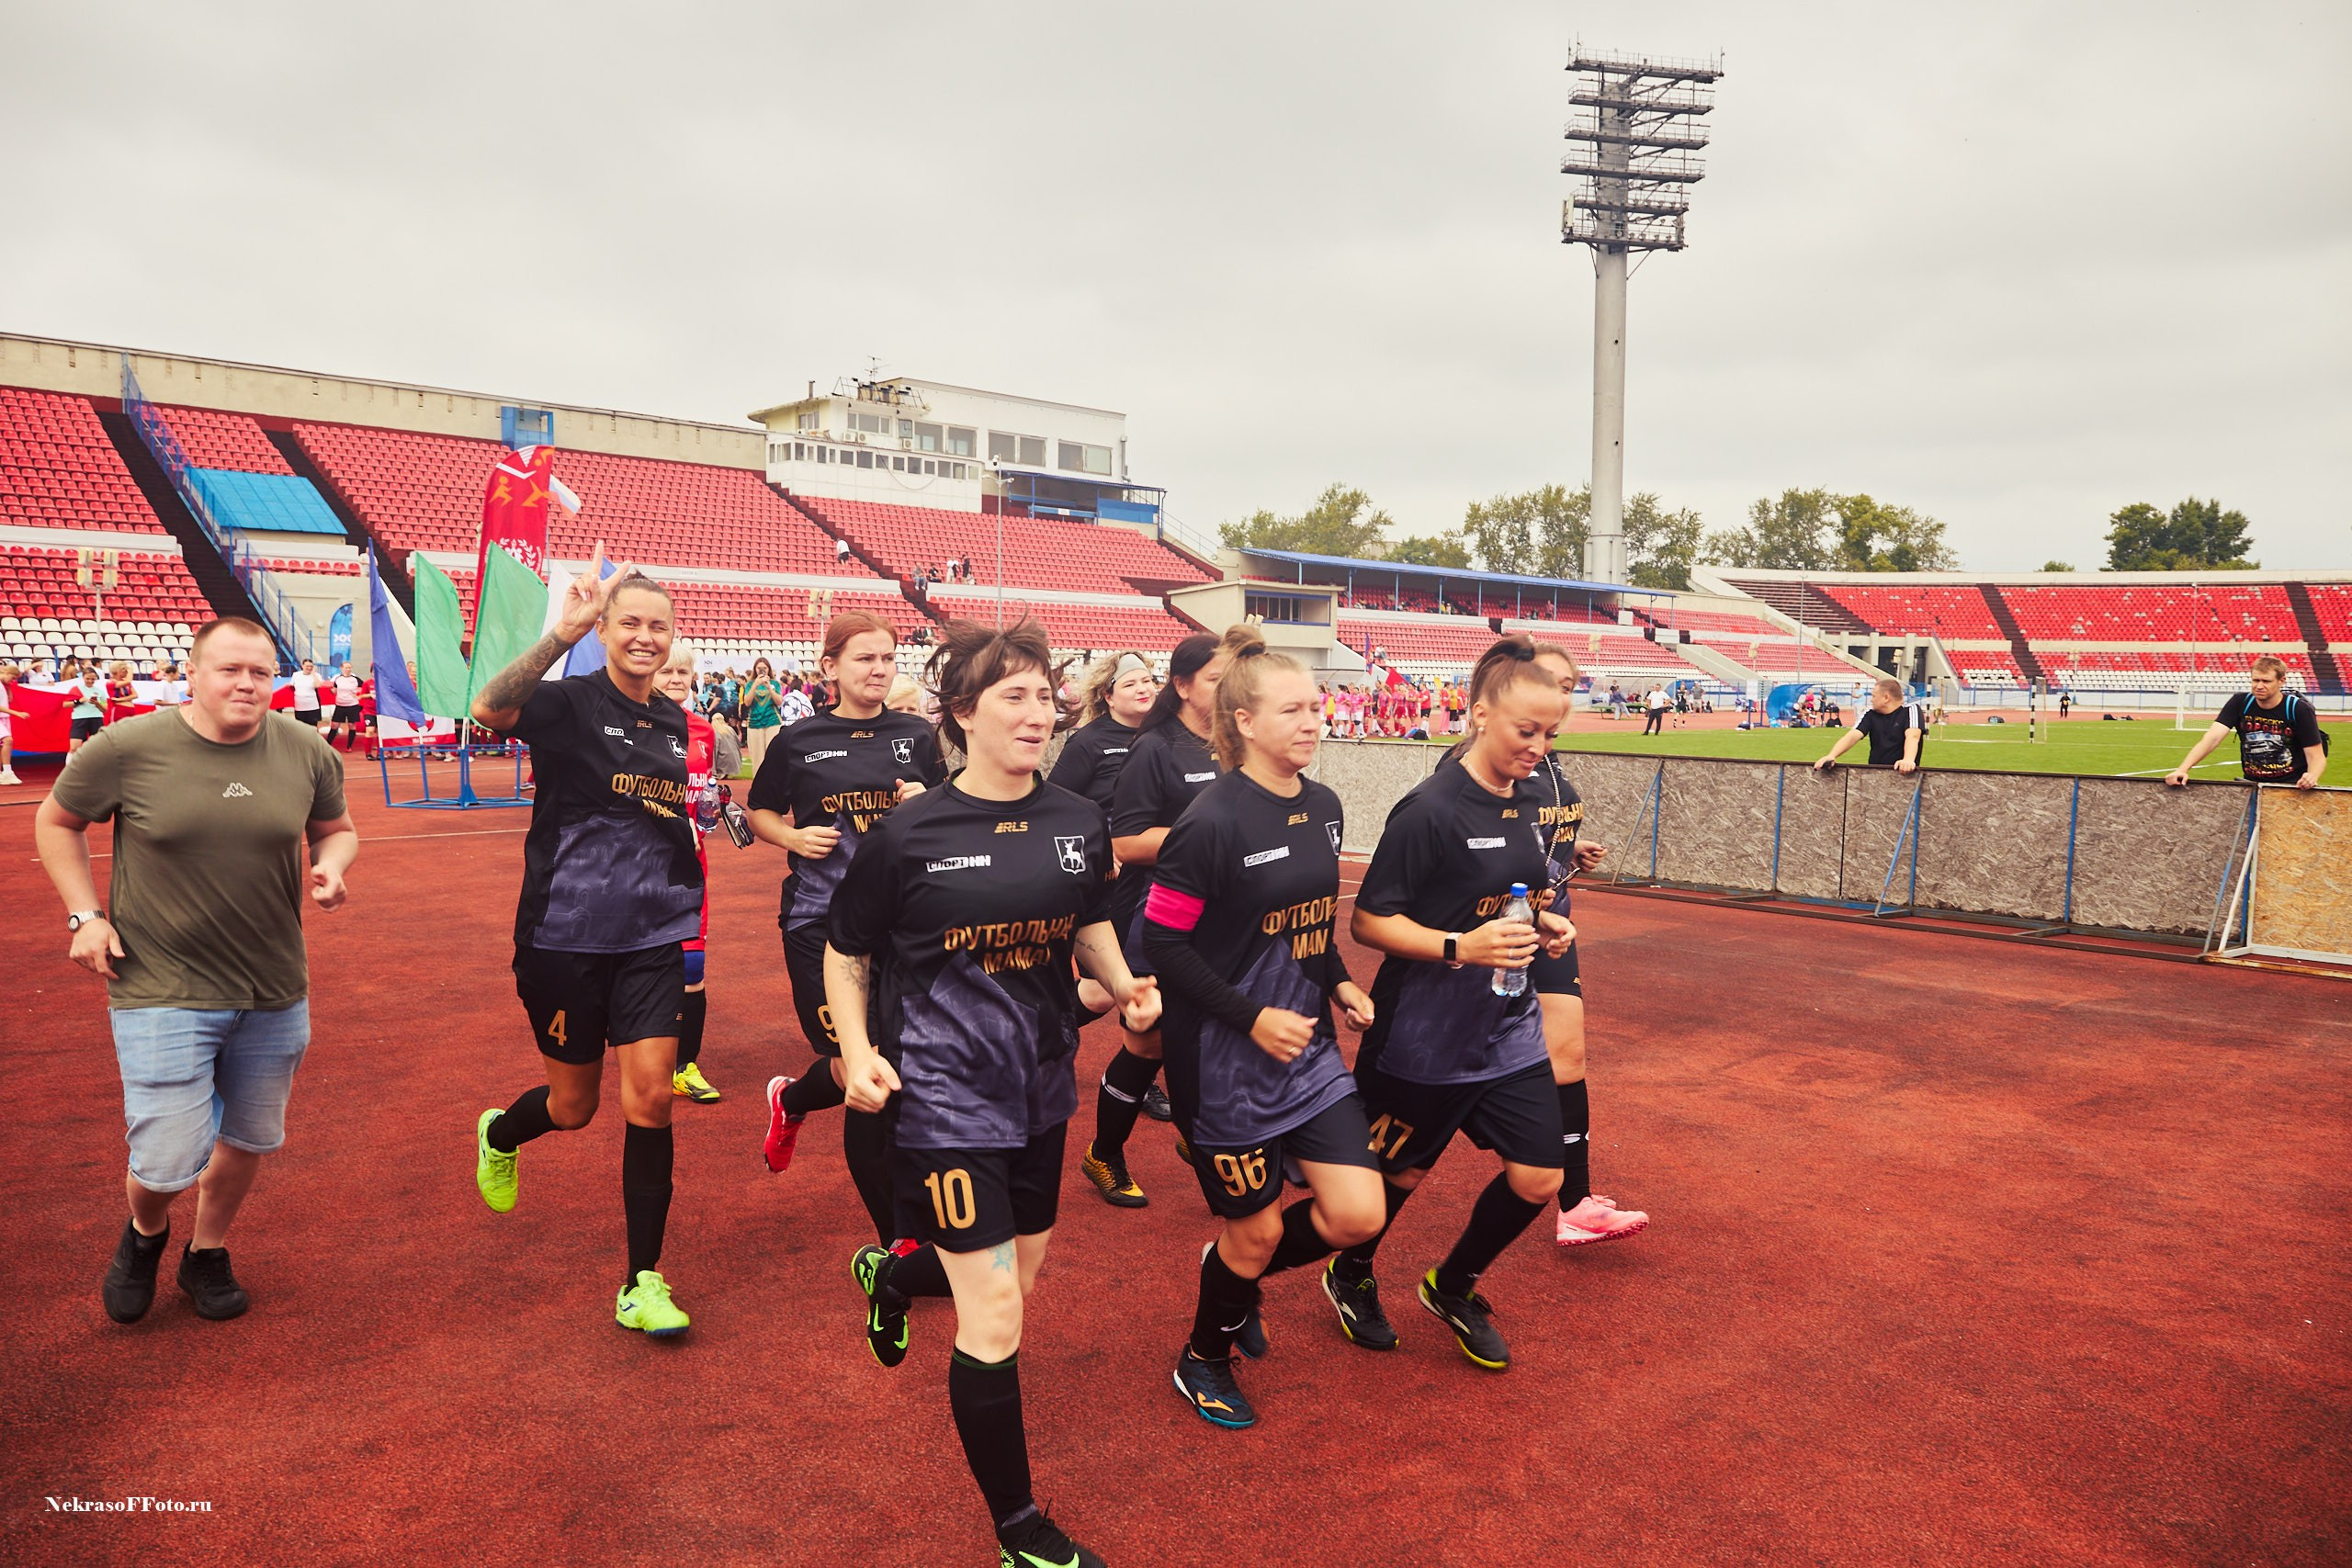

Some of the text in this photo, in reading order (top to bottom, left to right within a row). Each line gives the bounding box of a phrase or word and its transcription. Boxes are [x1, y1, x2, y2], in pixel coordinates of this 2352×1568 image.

[611, 773, 687, 805] ФУТБОЛЬН
[548, 1010, 568, 1046] 4
[1367, 1112, 1414, 1160] 47
[1213, 1148, 1267, 1197] 96
[924, 1168, 977, 1230] 10
